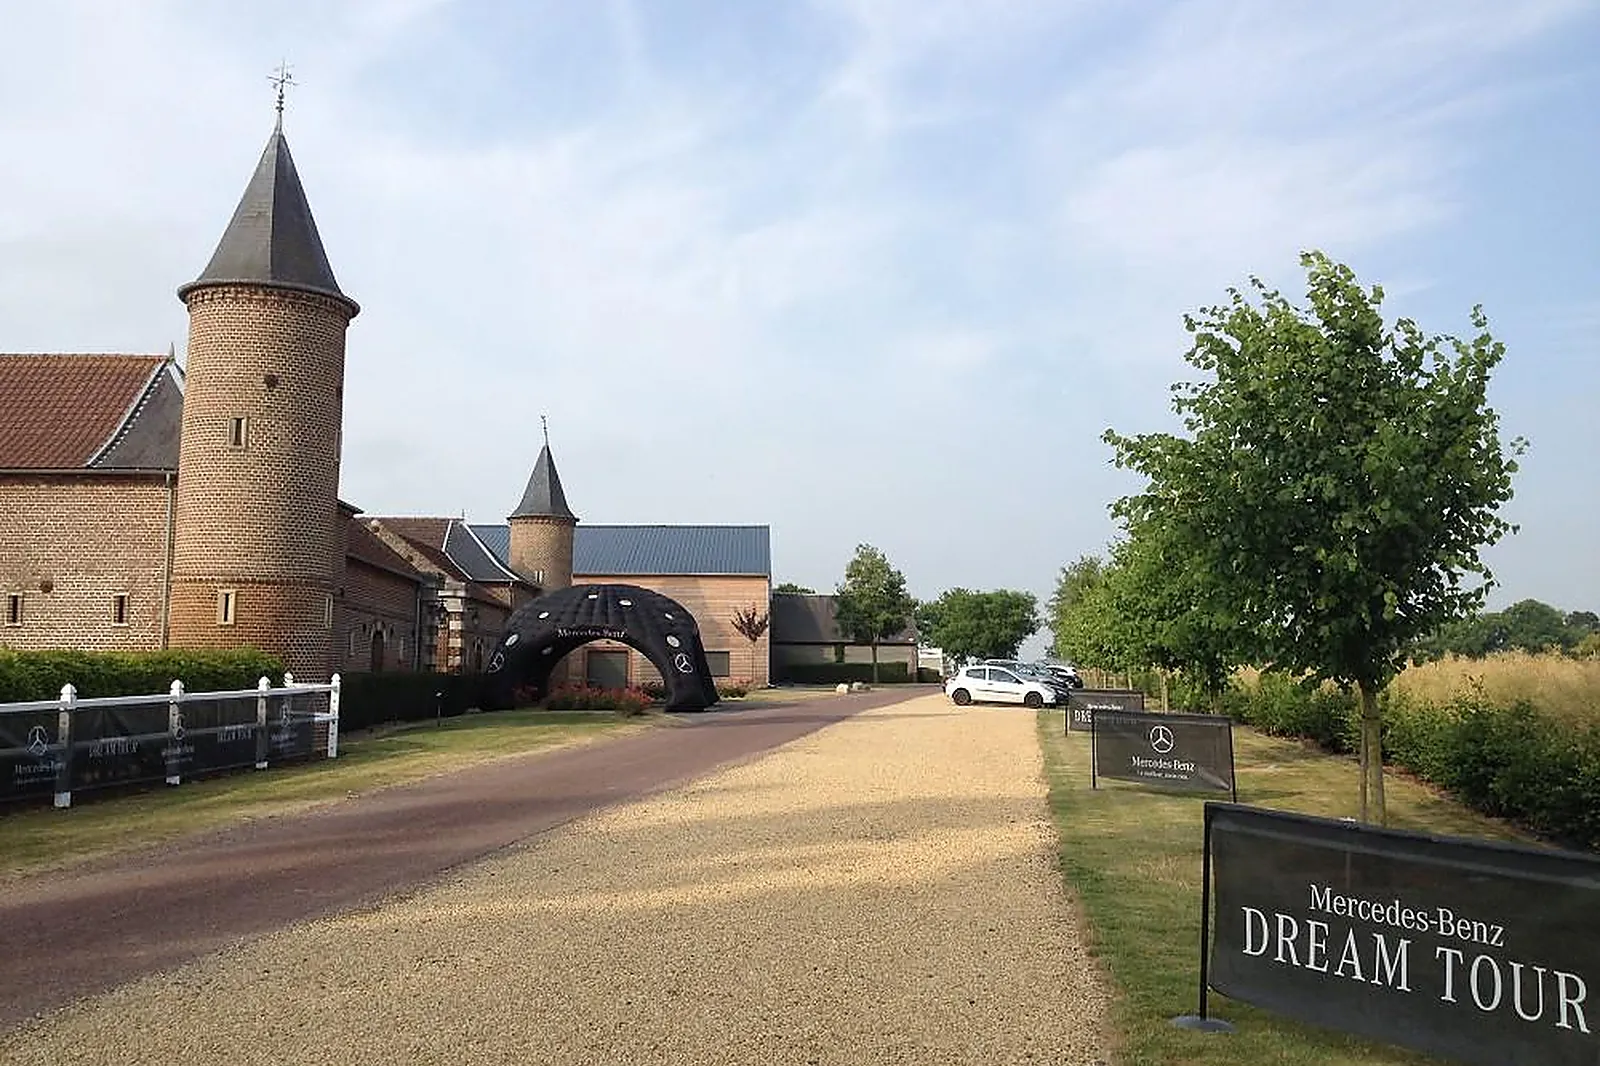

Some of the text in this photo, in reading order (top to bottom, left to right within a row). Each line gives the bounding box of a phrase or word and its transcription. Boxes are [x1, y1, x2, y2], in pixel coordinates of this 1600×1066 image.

[1131, 756, 1196, 772] Mercedes-Benz
[1309, 884, 1505, 948] Mercedes-Benz
[1241, 906, 1591, 1034] DREAM TOUR
